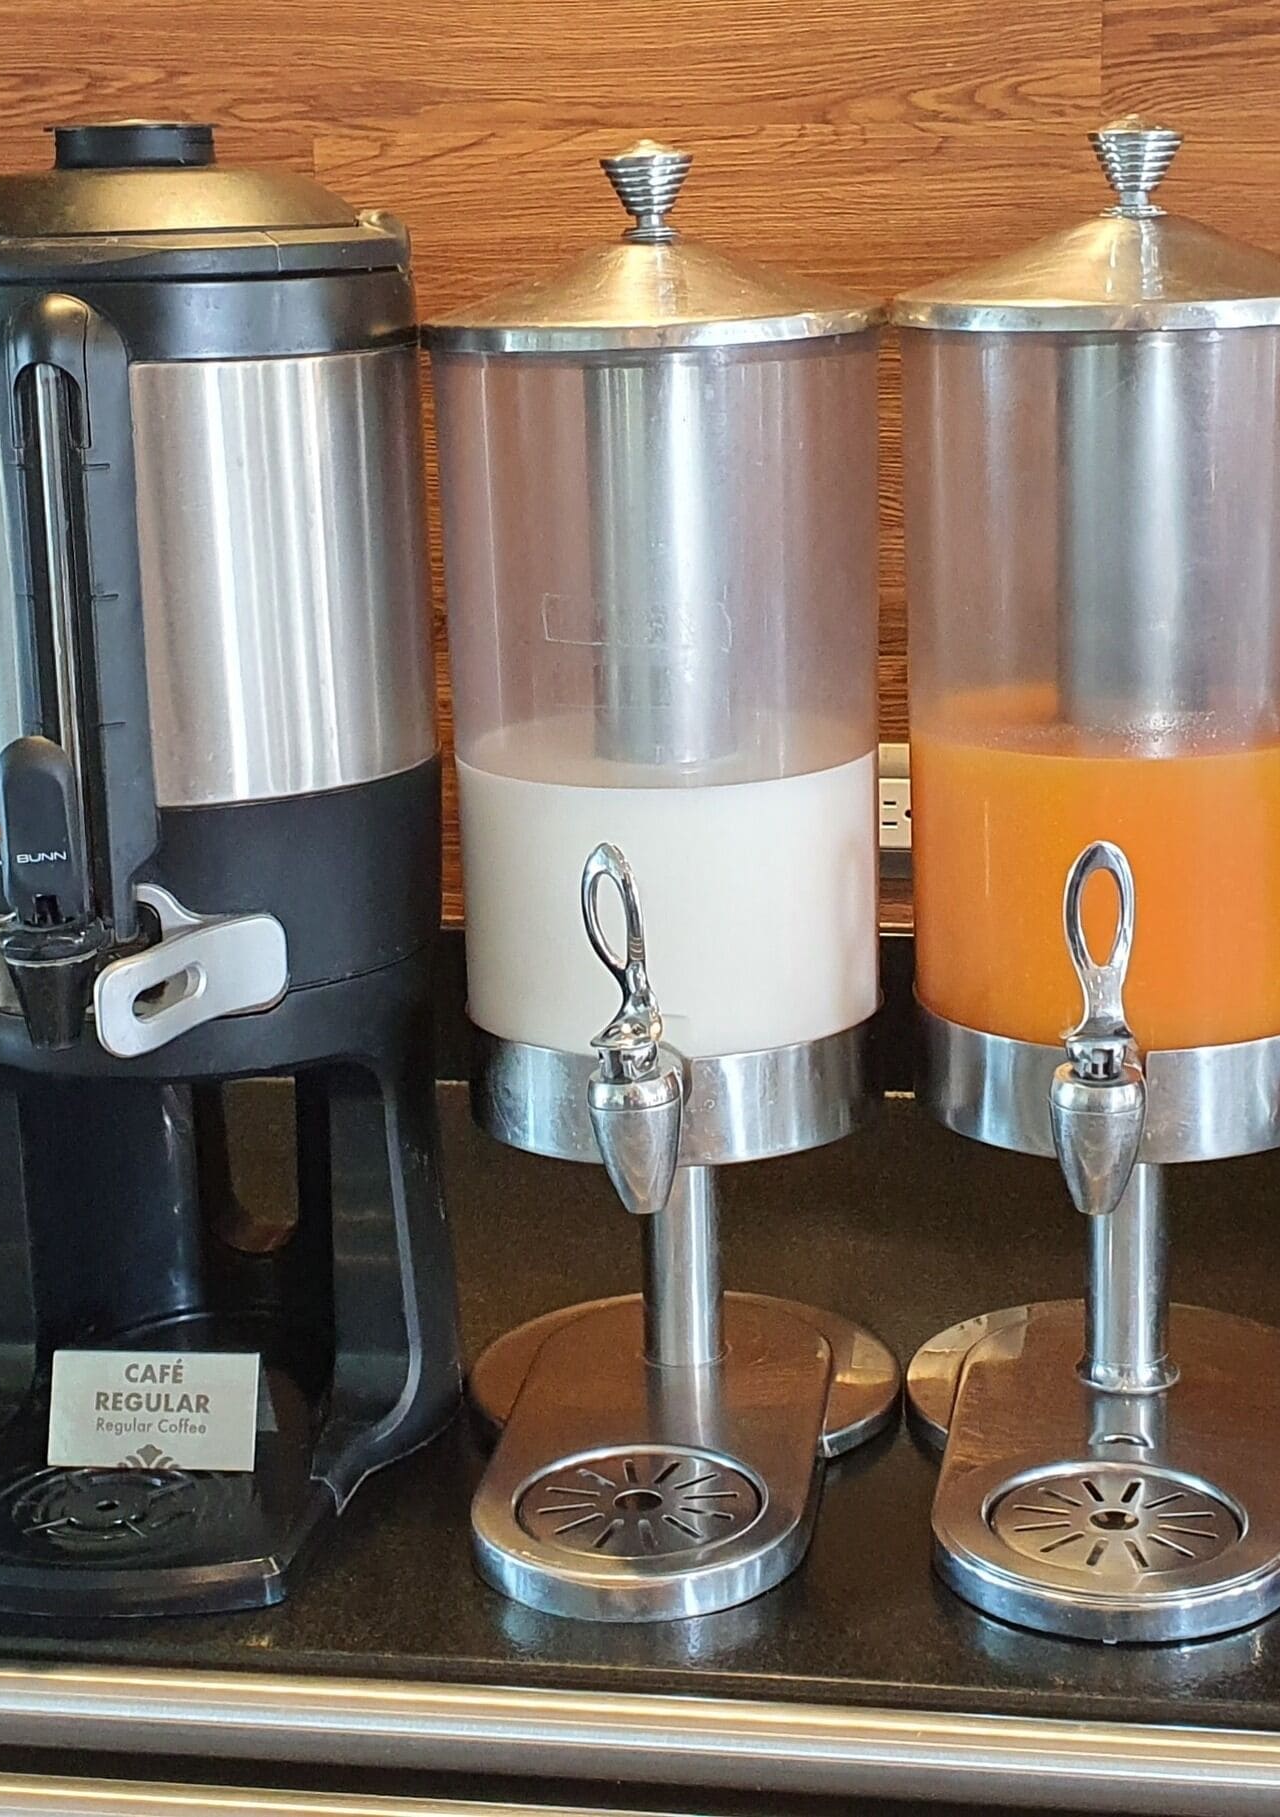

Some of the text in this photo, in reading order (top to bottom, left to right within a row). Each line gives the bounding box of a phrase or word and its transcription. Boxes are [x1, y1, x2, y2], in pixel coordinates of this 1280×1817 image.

[16, 851, 67, 863] BUNN
[124, 1358, 184, 1384] CAFÉ
[95, 1391, 210, 1414] REGULAR
[96, 1417, 207, 1436] Regular Coffee
